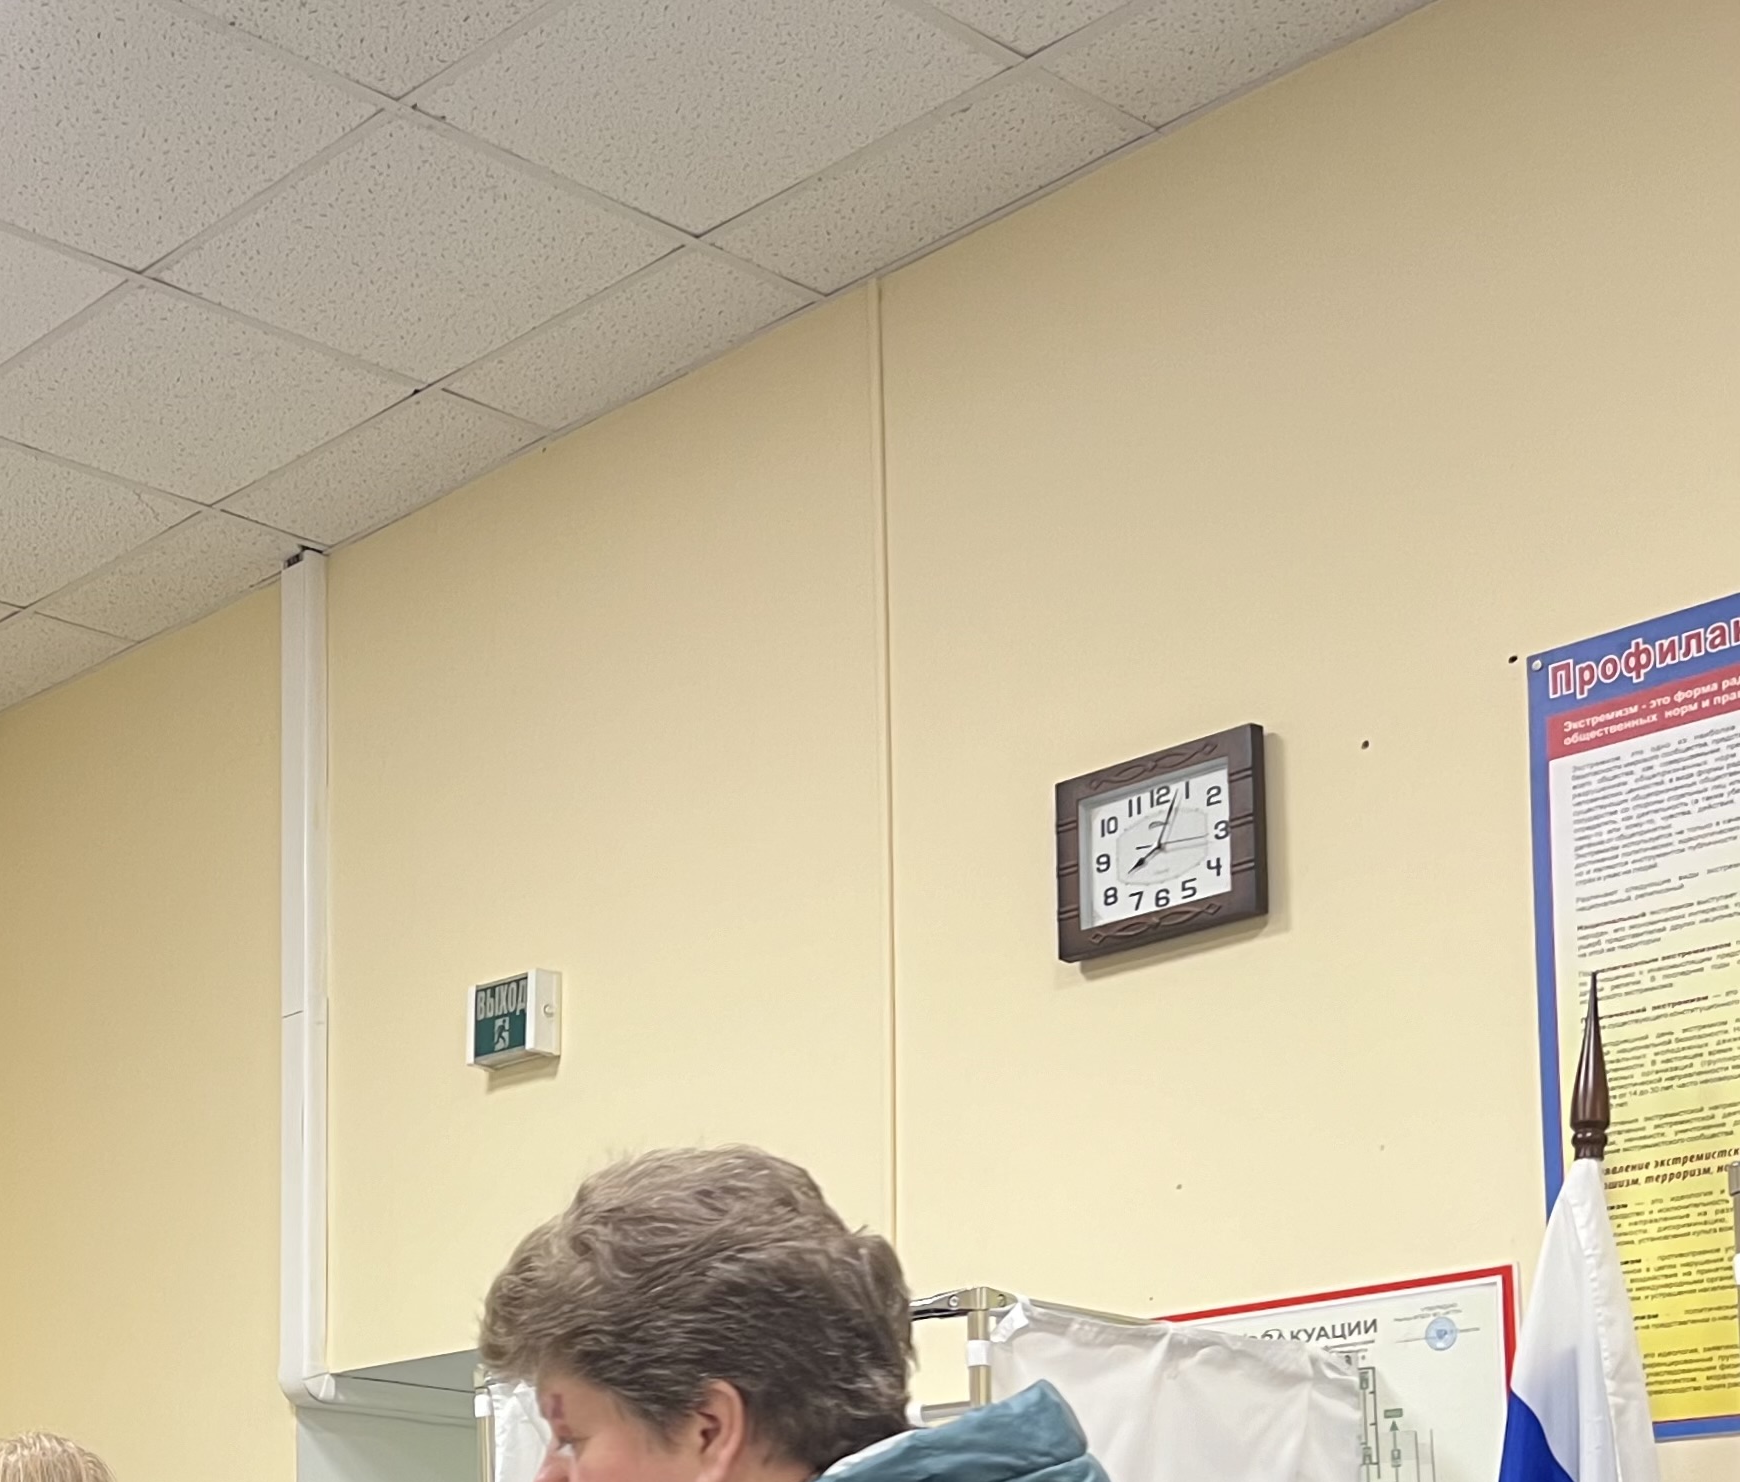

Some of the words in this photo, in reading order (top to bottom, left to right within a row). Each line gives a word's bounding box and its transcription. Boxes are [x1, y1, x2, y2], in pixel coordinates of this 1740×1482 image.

[1563, 705, 1639, 732] Экстремизм
[1649, 696, 1671, 709] это
[1673, 682, 1718, 704] форма
[1563, 713, 1658, 746] общественных
[1665, 701, 1699, 718] норм
[1701, 699, 1710, 708] и
[1713, 691, 1740, 705] пра
[1149, 785, 1170, 808] 12
[1184, 780, 1190, 799] 1
[1206, 785, 1222, 807] 2
[1127, 796, 1142, 818] 11
[1100, 816, 1118, 837] 10
[1214, 820, 1230, 840] 3
[1096, 853, 1111, 873] 9
[1206, 857, 1222, 876] 4
[1103, 886, 1118, 906] 8
[1155, 888, 1170, 908] 6
[1181, 878, 1197, 899] 5
[1129, 891, 1144, 911] 7
[476, 979, 527, 1021] ВЫХОД
[1654, 1148, 1740, 1170] экстремистск
[1645, 1166, 1714, 1185] терроризм,
